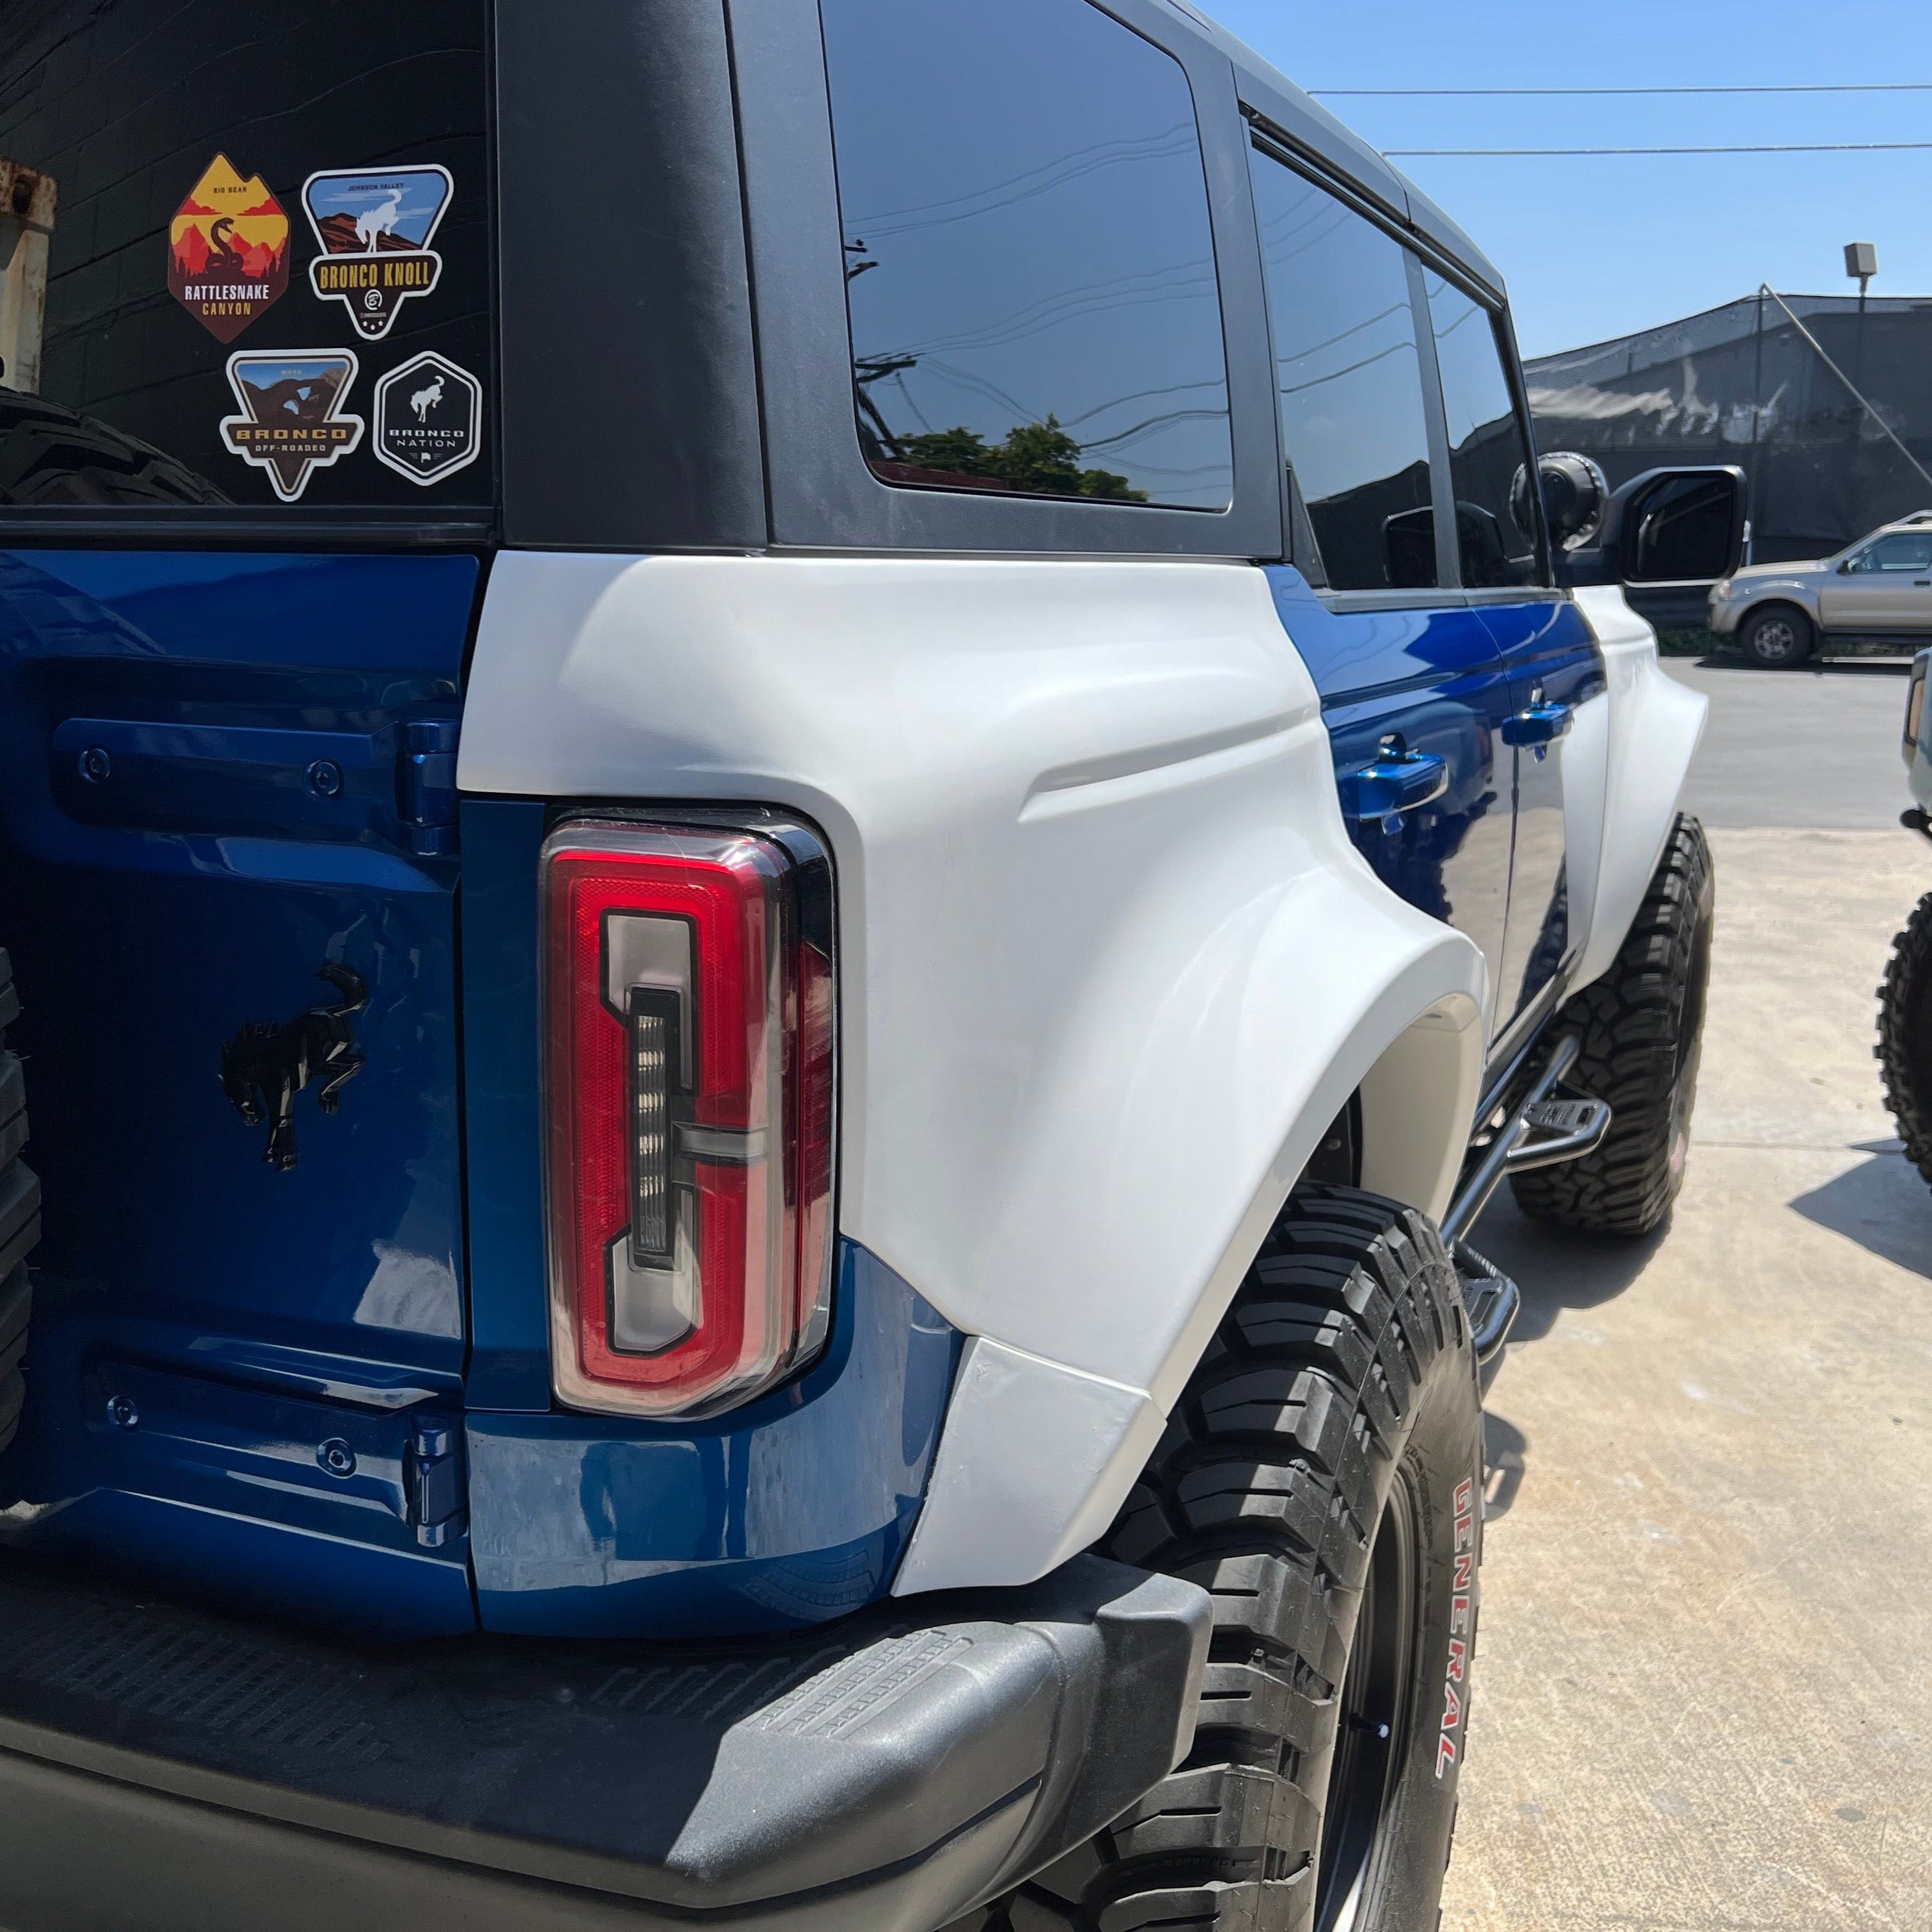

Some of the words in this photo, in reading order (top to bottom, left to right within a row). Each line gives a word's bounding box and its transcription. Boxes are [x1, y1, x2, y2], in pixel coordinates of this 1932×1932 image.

[320, 264, 378, 289] BRONCO
[384, 262, 429, 286] KNOLL
[184, 284, 269, 301] RATTLESNAKE
[202, 303, 251, 316] CANYON
[236, 429, 347, 440] BRONCO
[390, 429, 464, 438] BRONCO
[1434, 1476, 1473, 1780] GENERAL
